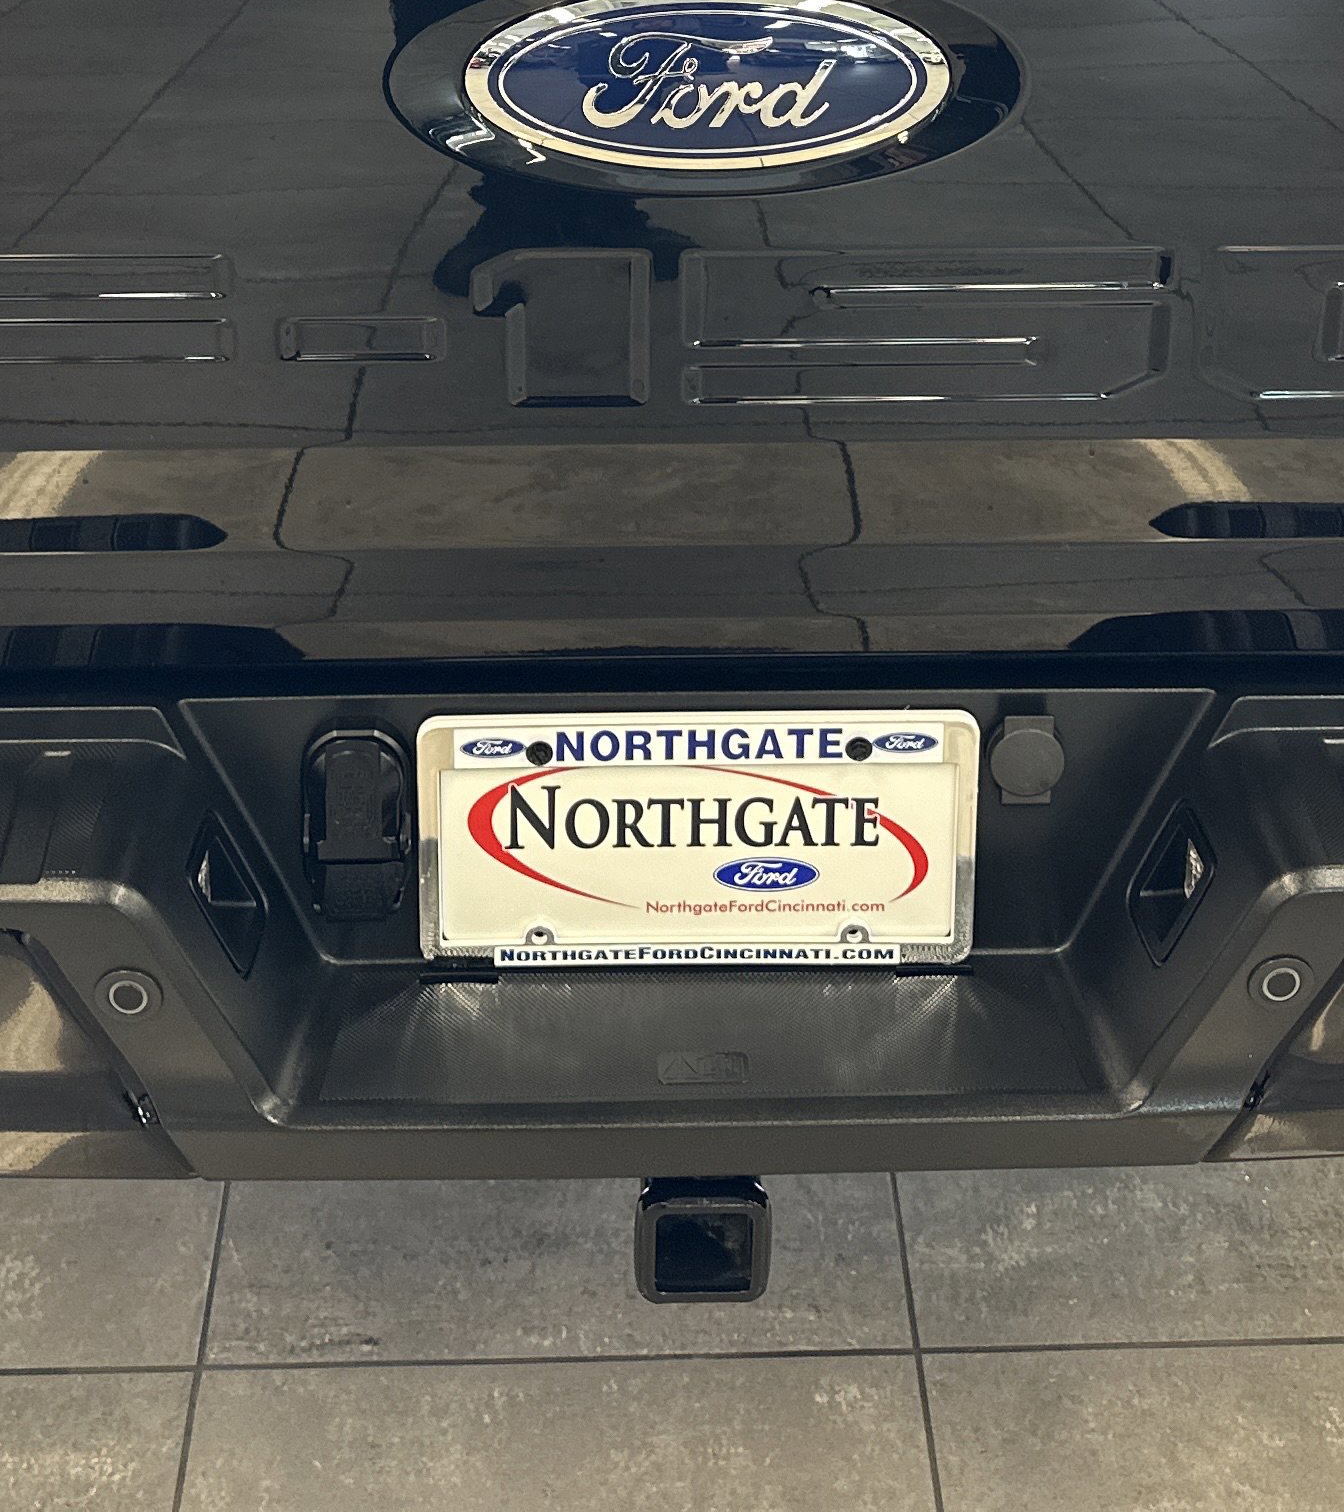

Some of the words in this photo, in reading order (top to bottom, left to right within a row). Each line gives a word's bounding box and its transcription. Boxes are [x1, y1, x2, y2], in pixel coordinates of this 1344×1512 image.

[581, 31, 838, 129] Ford
[472, 739, 514, 755] Ford
[556, 728, 843, 762] NORTHGATE
[884, 734, 925, 749] Ford
[504, 785, 880, 850] NORTHGATE
[733, 861, 798, 886] Ford
[645, 899, 886, 916] NorthgateFordCincinnati.com
